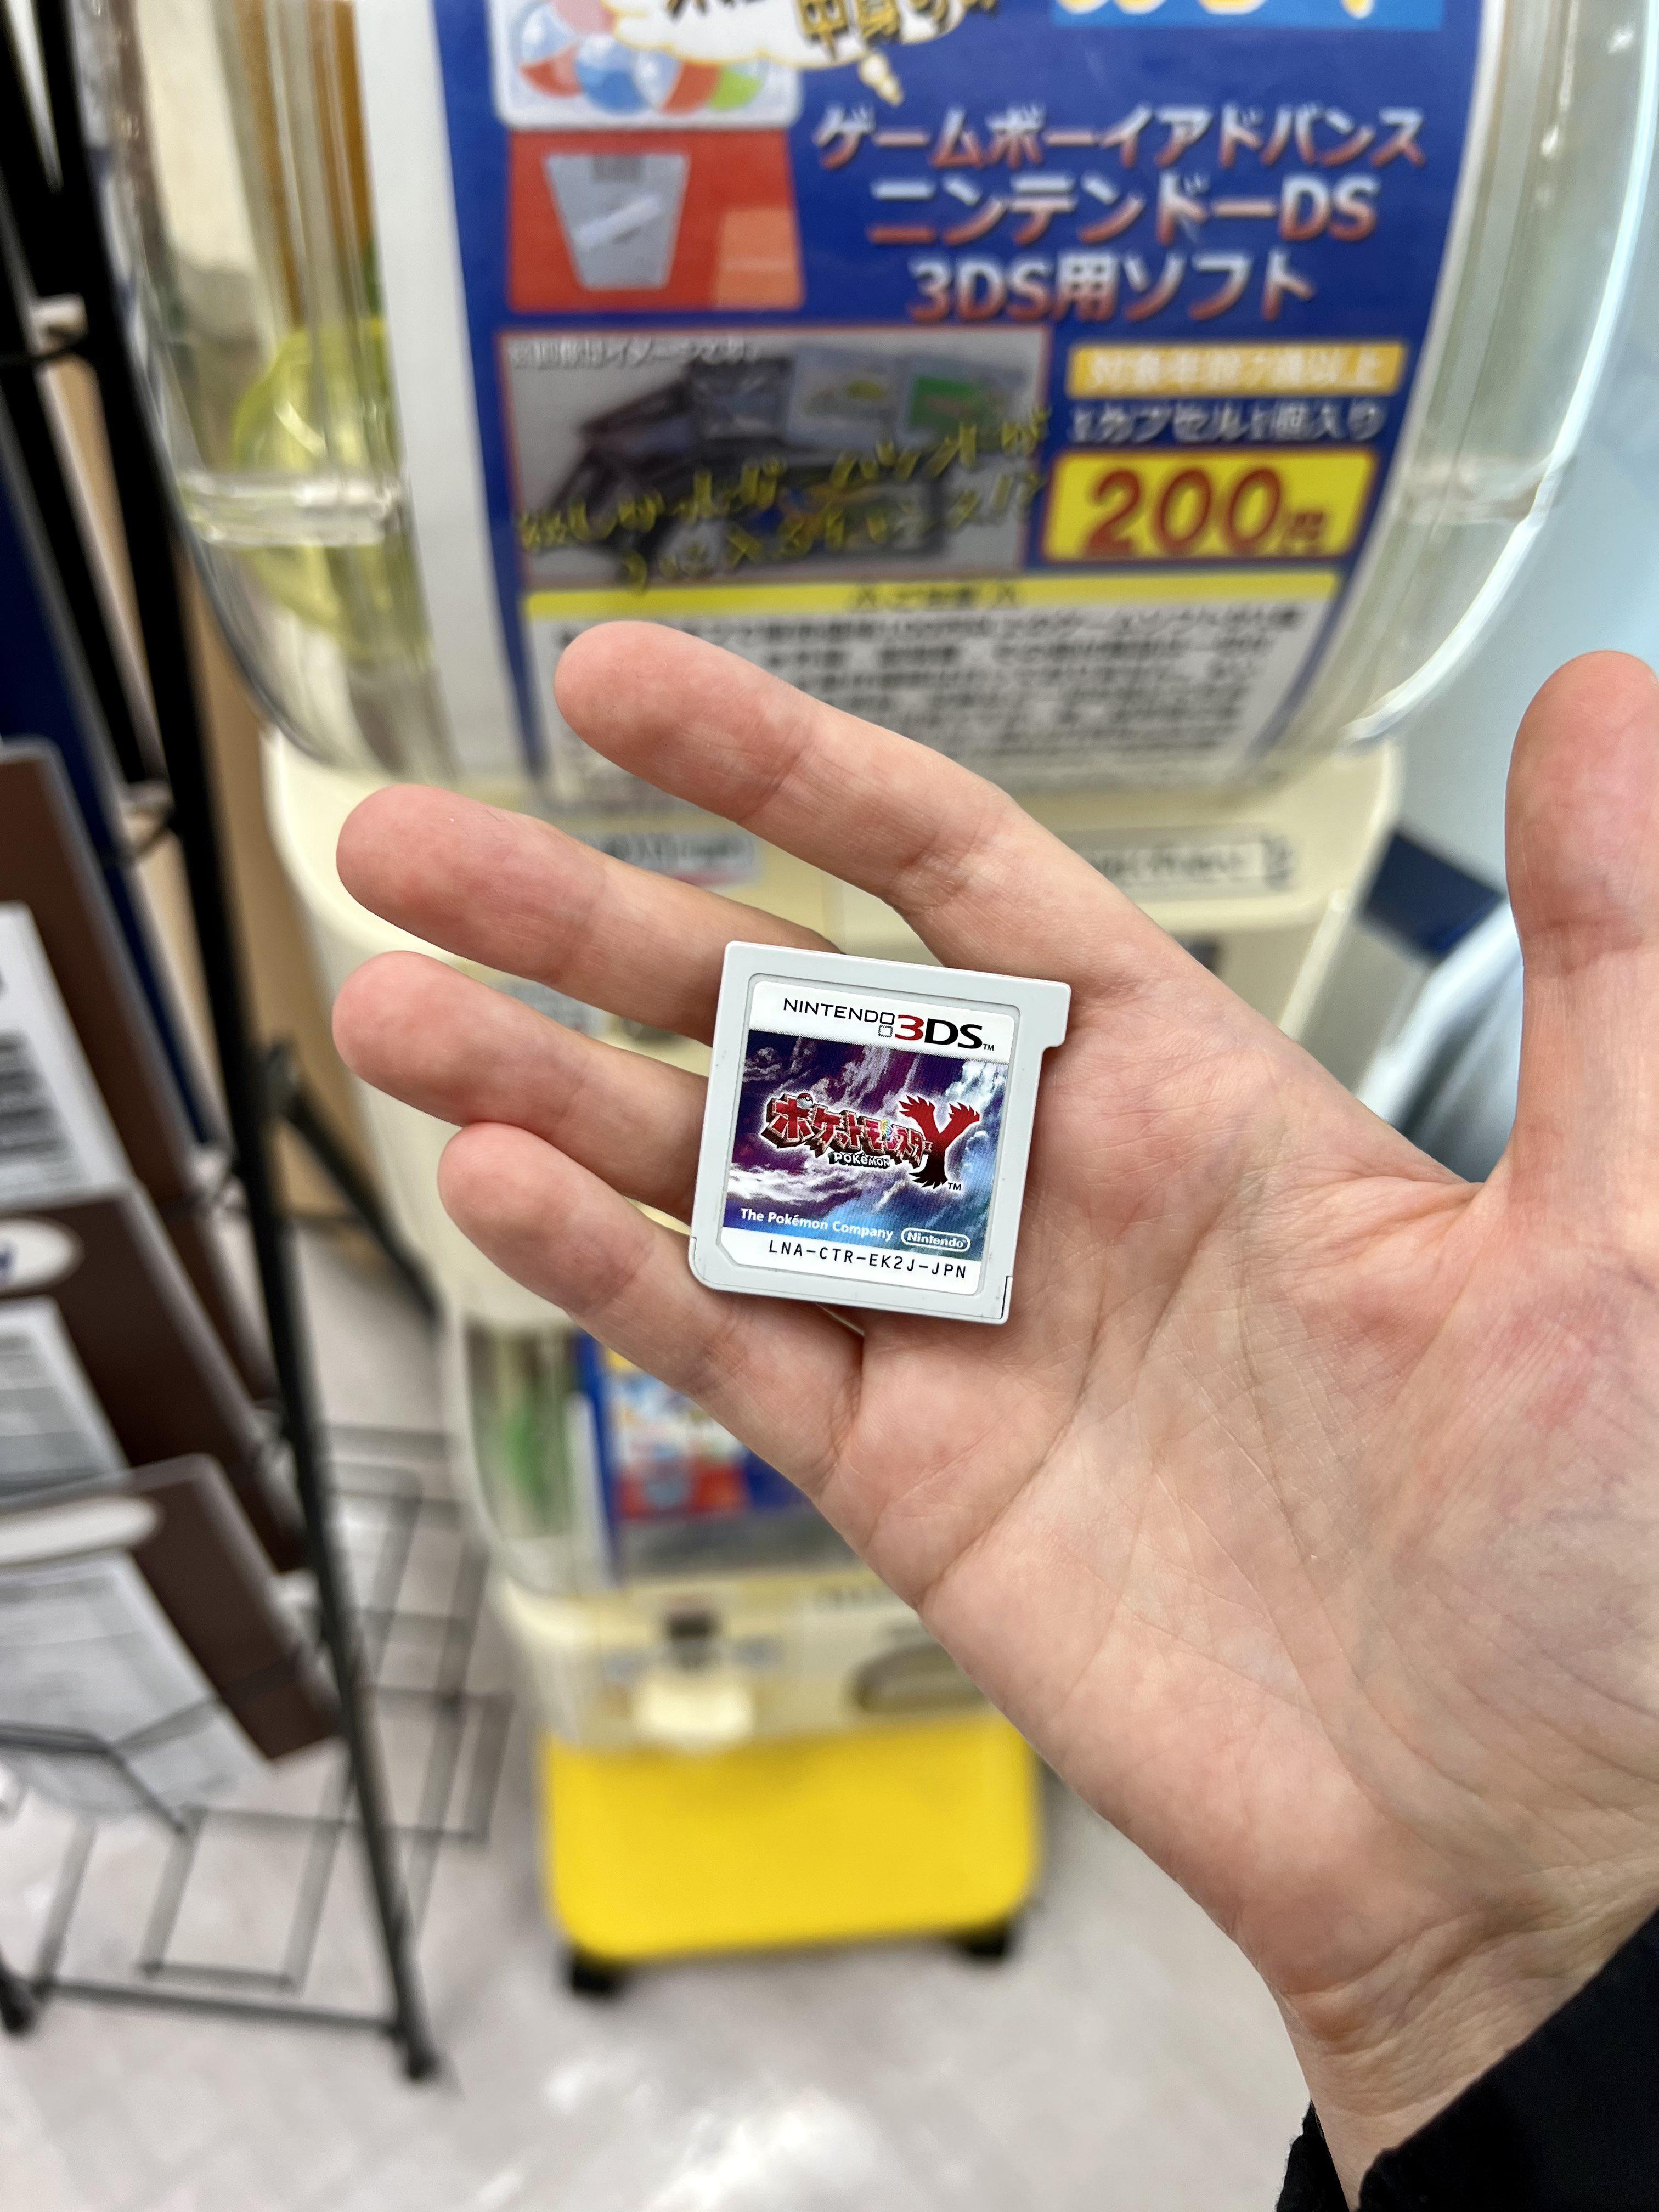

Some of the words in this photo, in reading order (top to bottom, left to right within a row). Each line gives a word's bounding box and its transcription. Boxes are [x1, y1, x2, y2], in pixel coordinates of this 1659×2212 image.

[866, 171, 1381, 245] ニンテンドーDS
[905, 247, 1314, 323] 3DS用ソフト
[783, 997, 895, 1025] NINTENDO
[740, 1207, 764, 1223] The
[768, 1213, 828, 1231] Pokémon
[832, 1221, 894, 1242] Company
[906, 1231, 967, 1249] Nintendo
[768, 1239, 967, 1279] LNA-CTR-EK2J-JPN
